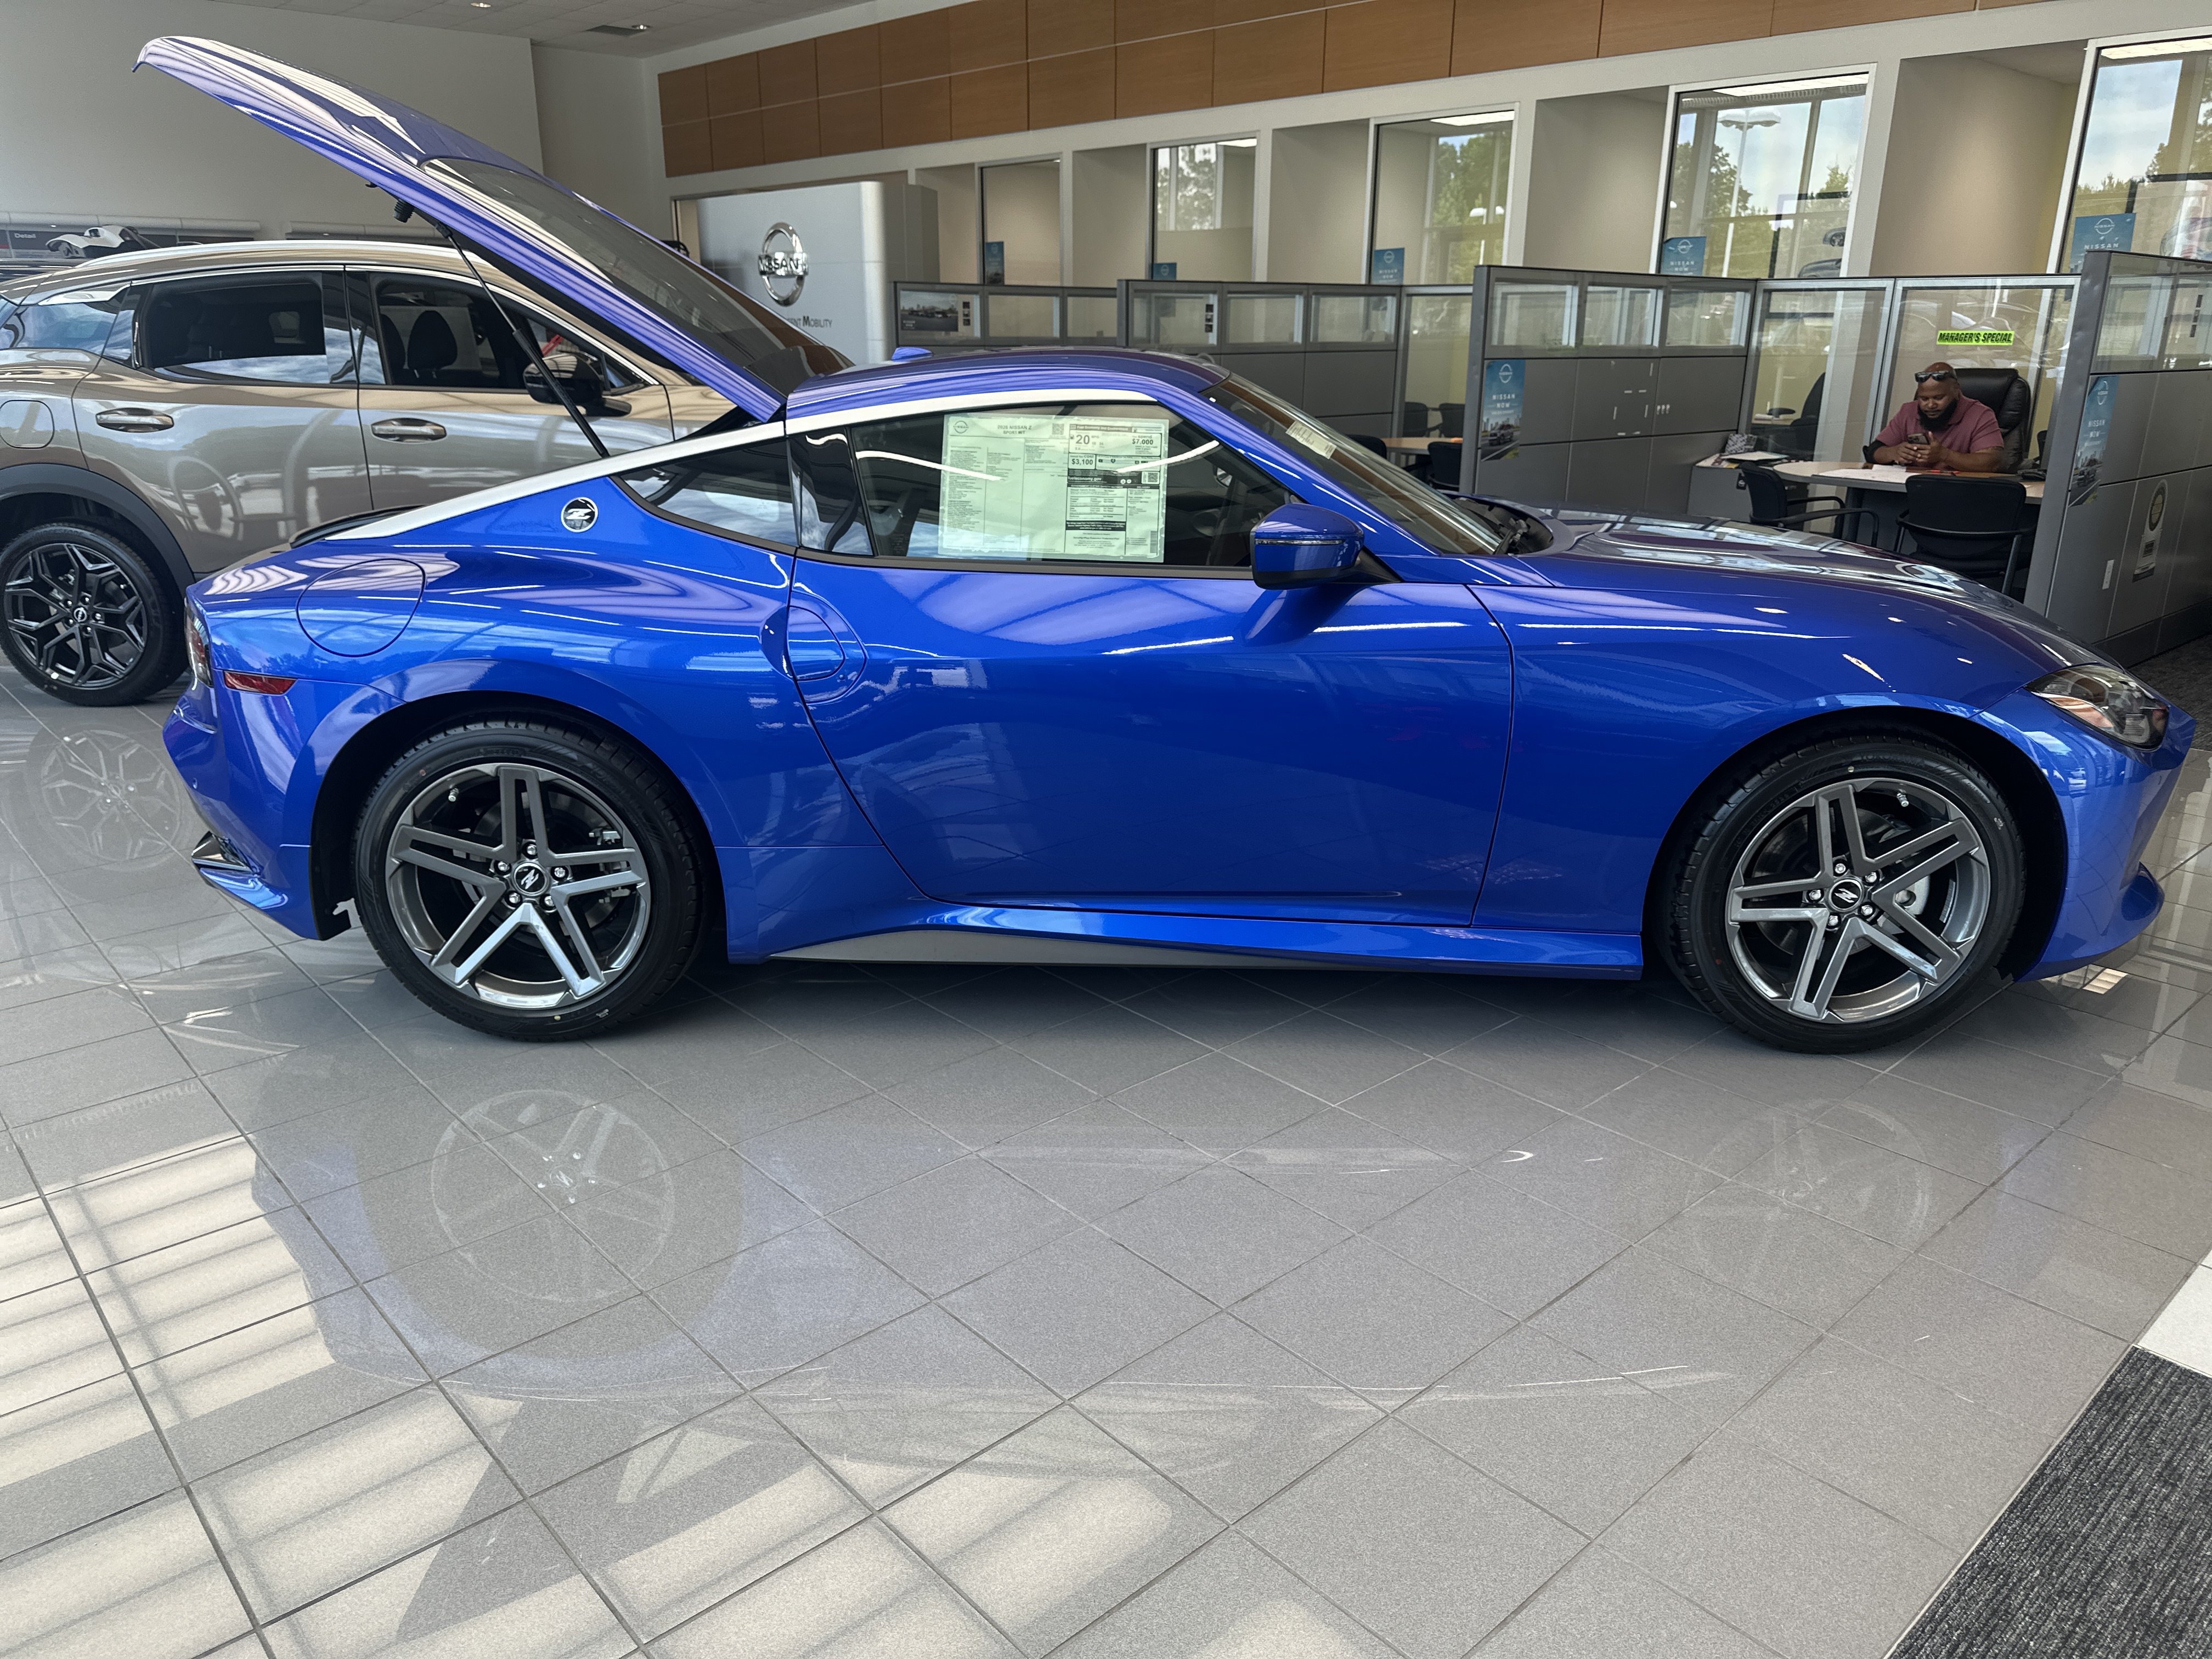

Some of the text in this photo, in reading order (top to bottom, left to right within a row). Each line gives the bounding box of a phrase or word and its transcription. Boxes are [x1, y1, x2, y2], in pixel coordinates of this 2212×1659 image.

[1938, 332, 2013, 343] MANAGER'S SPECIAL
[1076, 435, 1090, 444] 20
